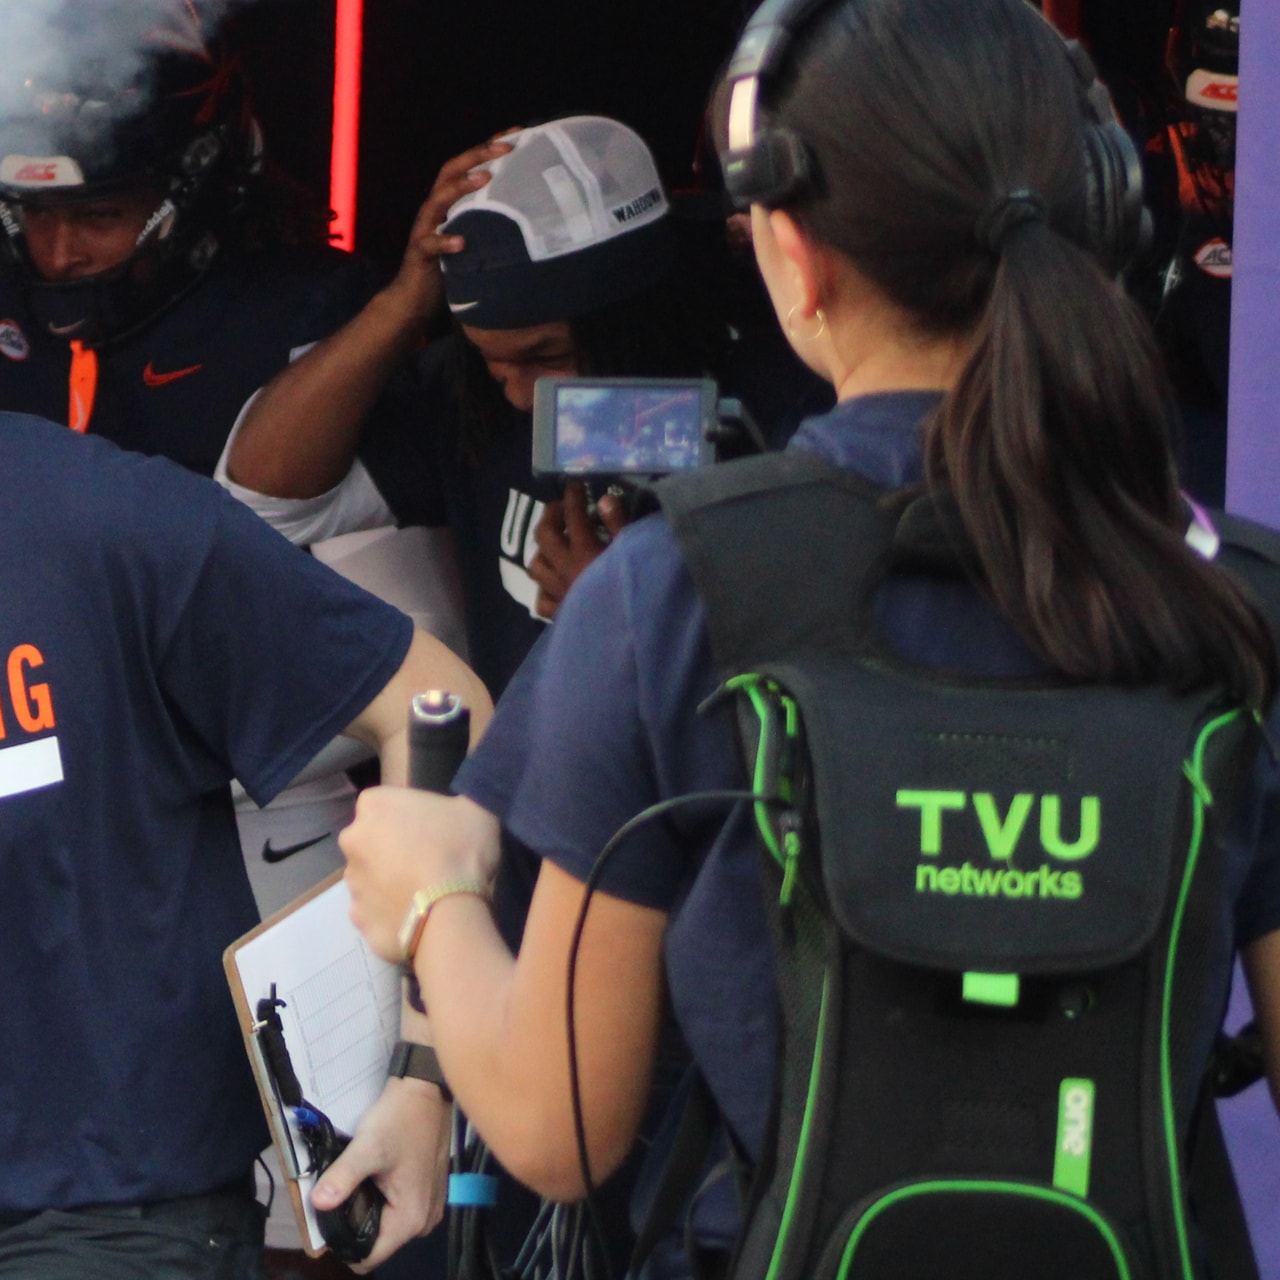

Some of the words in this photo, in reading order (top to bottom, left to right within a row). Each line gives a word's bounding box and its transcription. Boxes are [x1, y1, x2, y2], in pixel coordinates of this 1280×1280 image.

[1201, 247, 1233, 265] AC
[897, 791, 1099, 859] TVU
[916, 863, 1083, 899] networks
[1062, 1088, 1089, 1157] one
